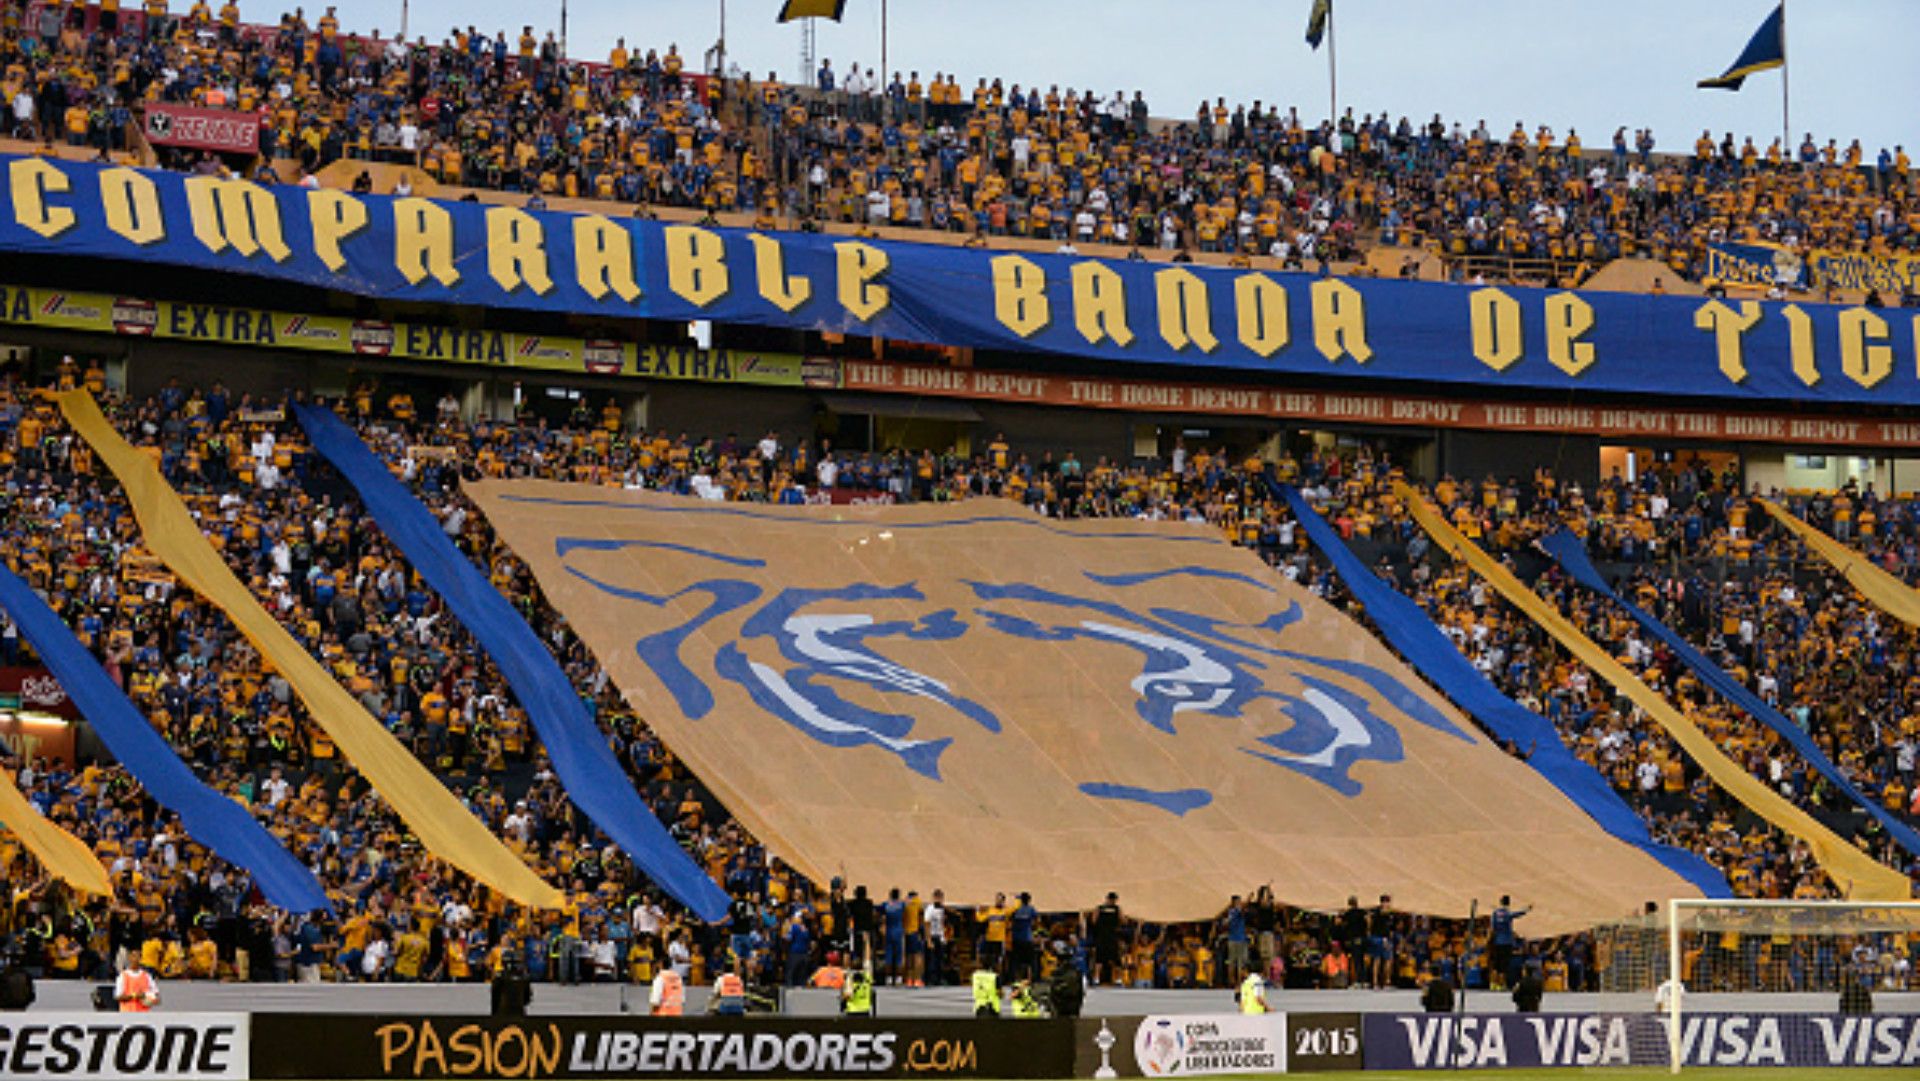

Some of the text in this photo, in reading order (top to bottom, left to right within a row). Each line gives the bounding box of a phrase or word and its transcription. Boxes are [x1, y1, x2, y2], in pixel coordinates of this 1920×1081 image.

[170, 303, 276, 344] EXTRA
[406, 324, 507, 363] EXTRA
[635, 345, 732, 380] EXTRA
[848, 363, 895, 386] THE
[902, 367, 967, 391] HOME
[974, 372, 1048, 397] DEPOT
[1069, 381, 1262, 409] THE HOME DEPOT
[1270, 392, 1463, 422] THE HOME DEPOT
[1484, 404, 1673, 431] THE HOME DEPOT
[1674, 413, 1861, 441] THE HOME DEPOT
[374, 1020, 562, 1078] PASION
[1295, 1027, 1359, 1056] 2015
[1397, 1017, 1507, 1067] VISA
[1526, 1017, 1630, 1066] VISA
[1657, 1016, 1785, 1065] VISA
